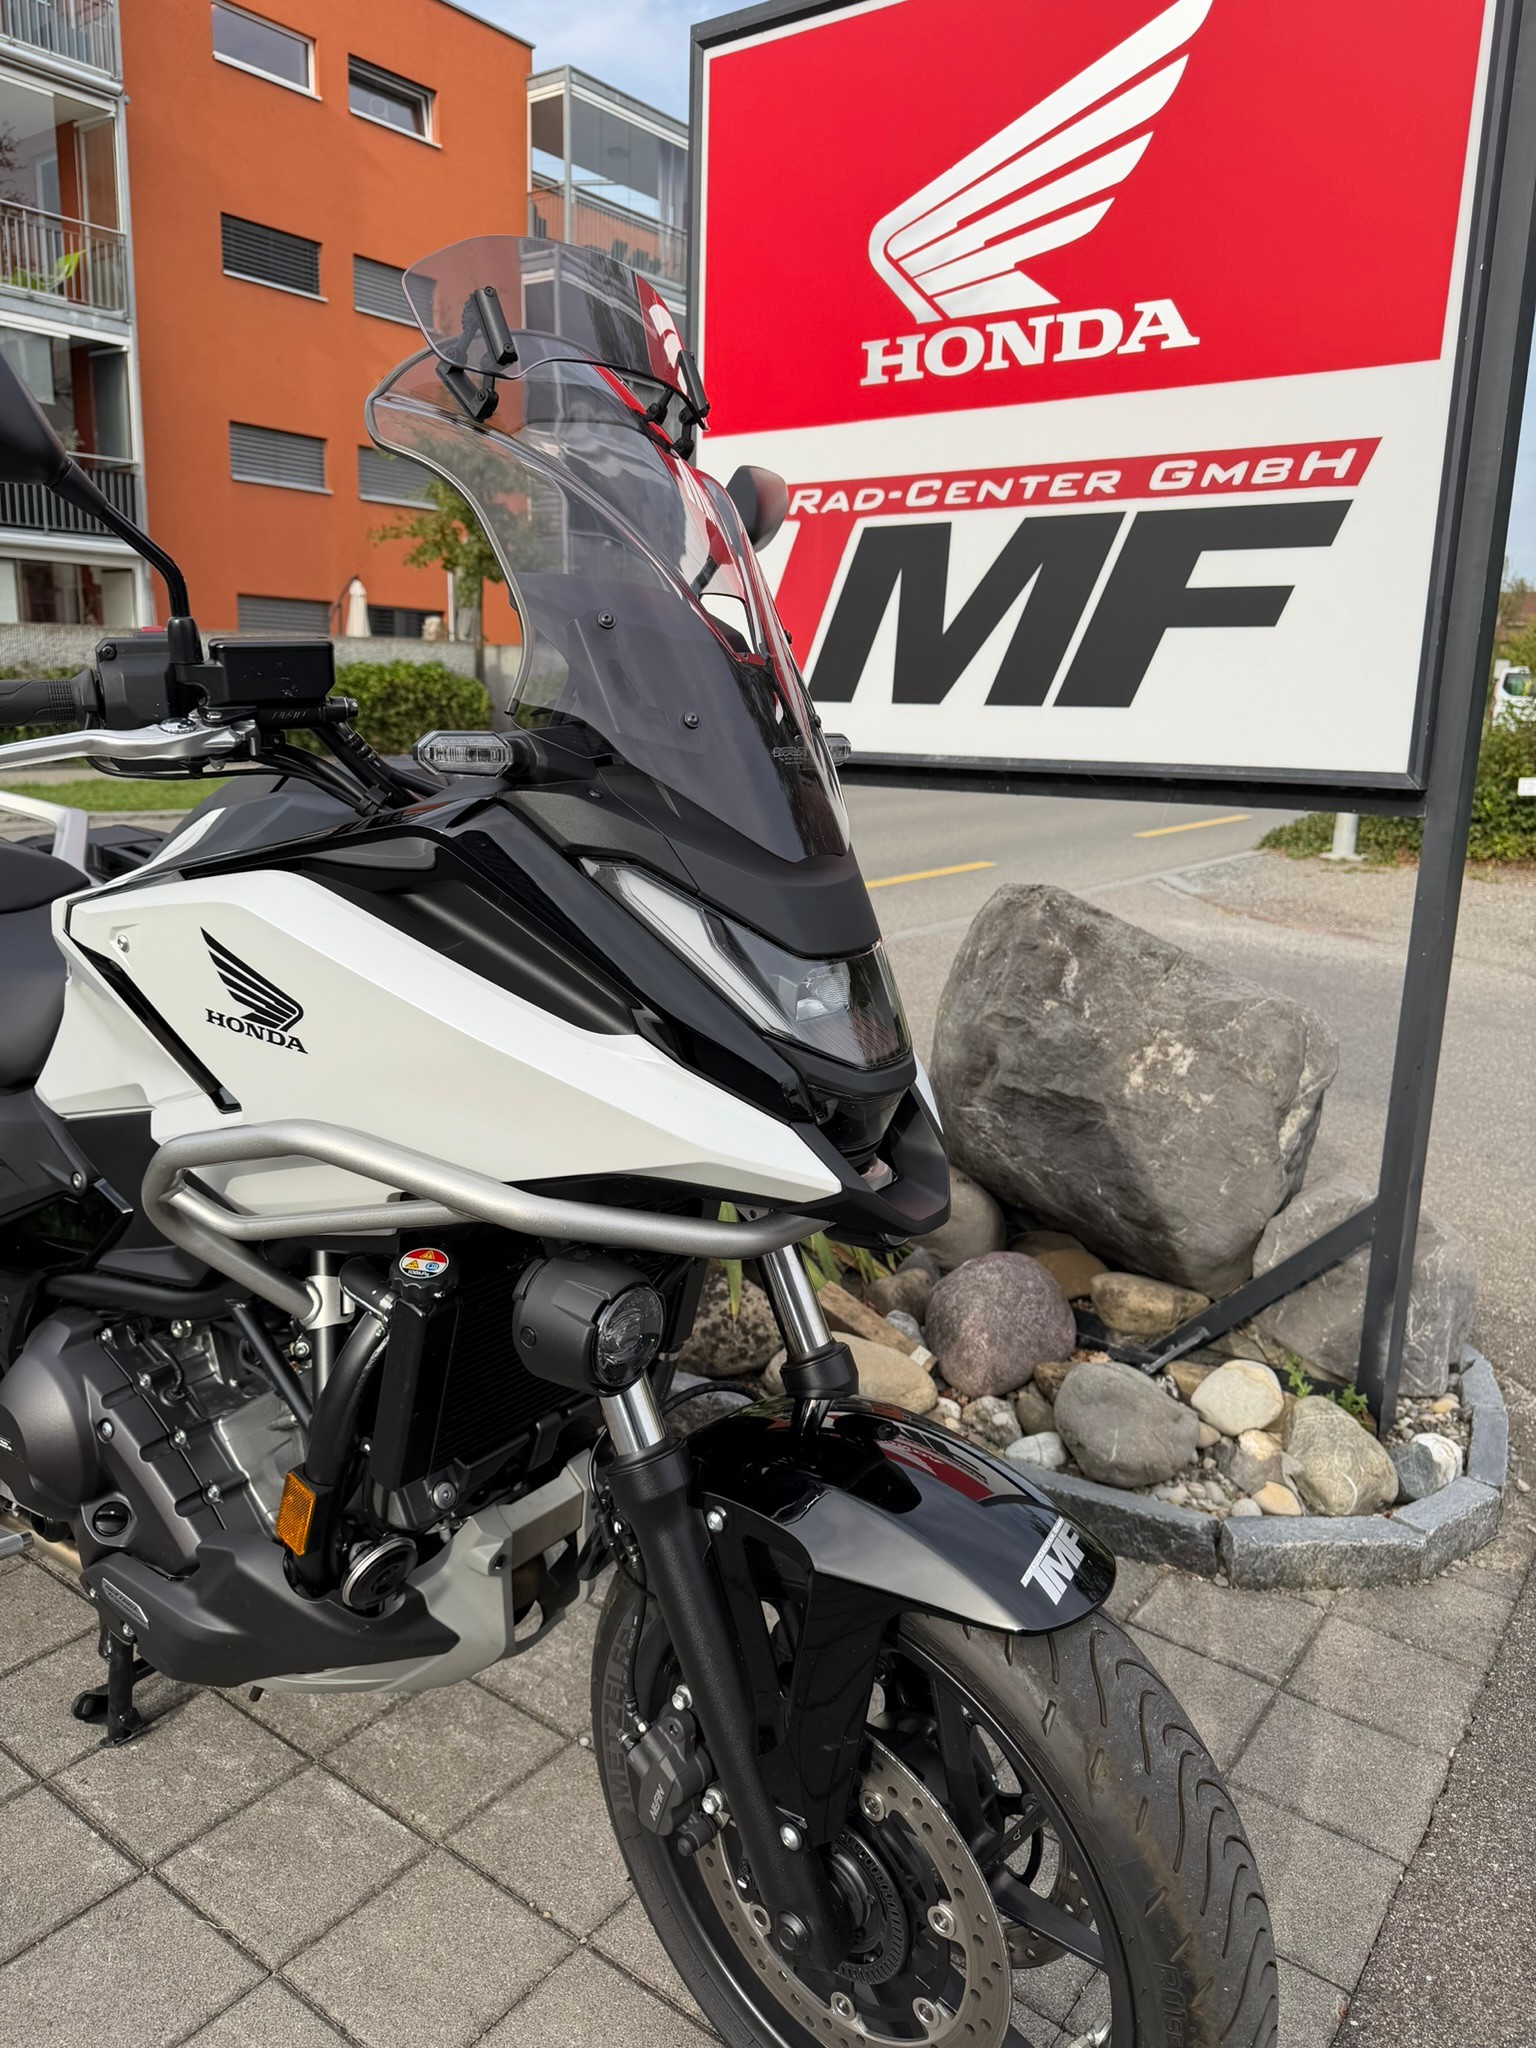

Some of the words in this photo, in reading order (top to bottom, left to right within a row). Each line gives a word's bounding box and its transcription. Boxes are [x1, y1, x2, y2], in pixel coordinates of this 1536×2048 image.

[859, 298, 1201, 387] HONDA
[204, 1008, 309, 1055] HONDA
[1030, 1520, 1085, 1606] TMF
